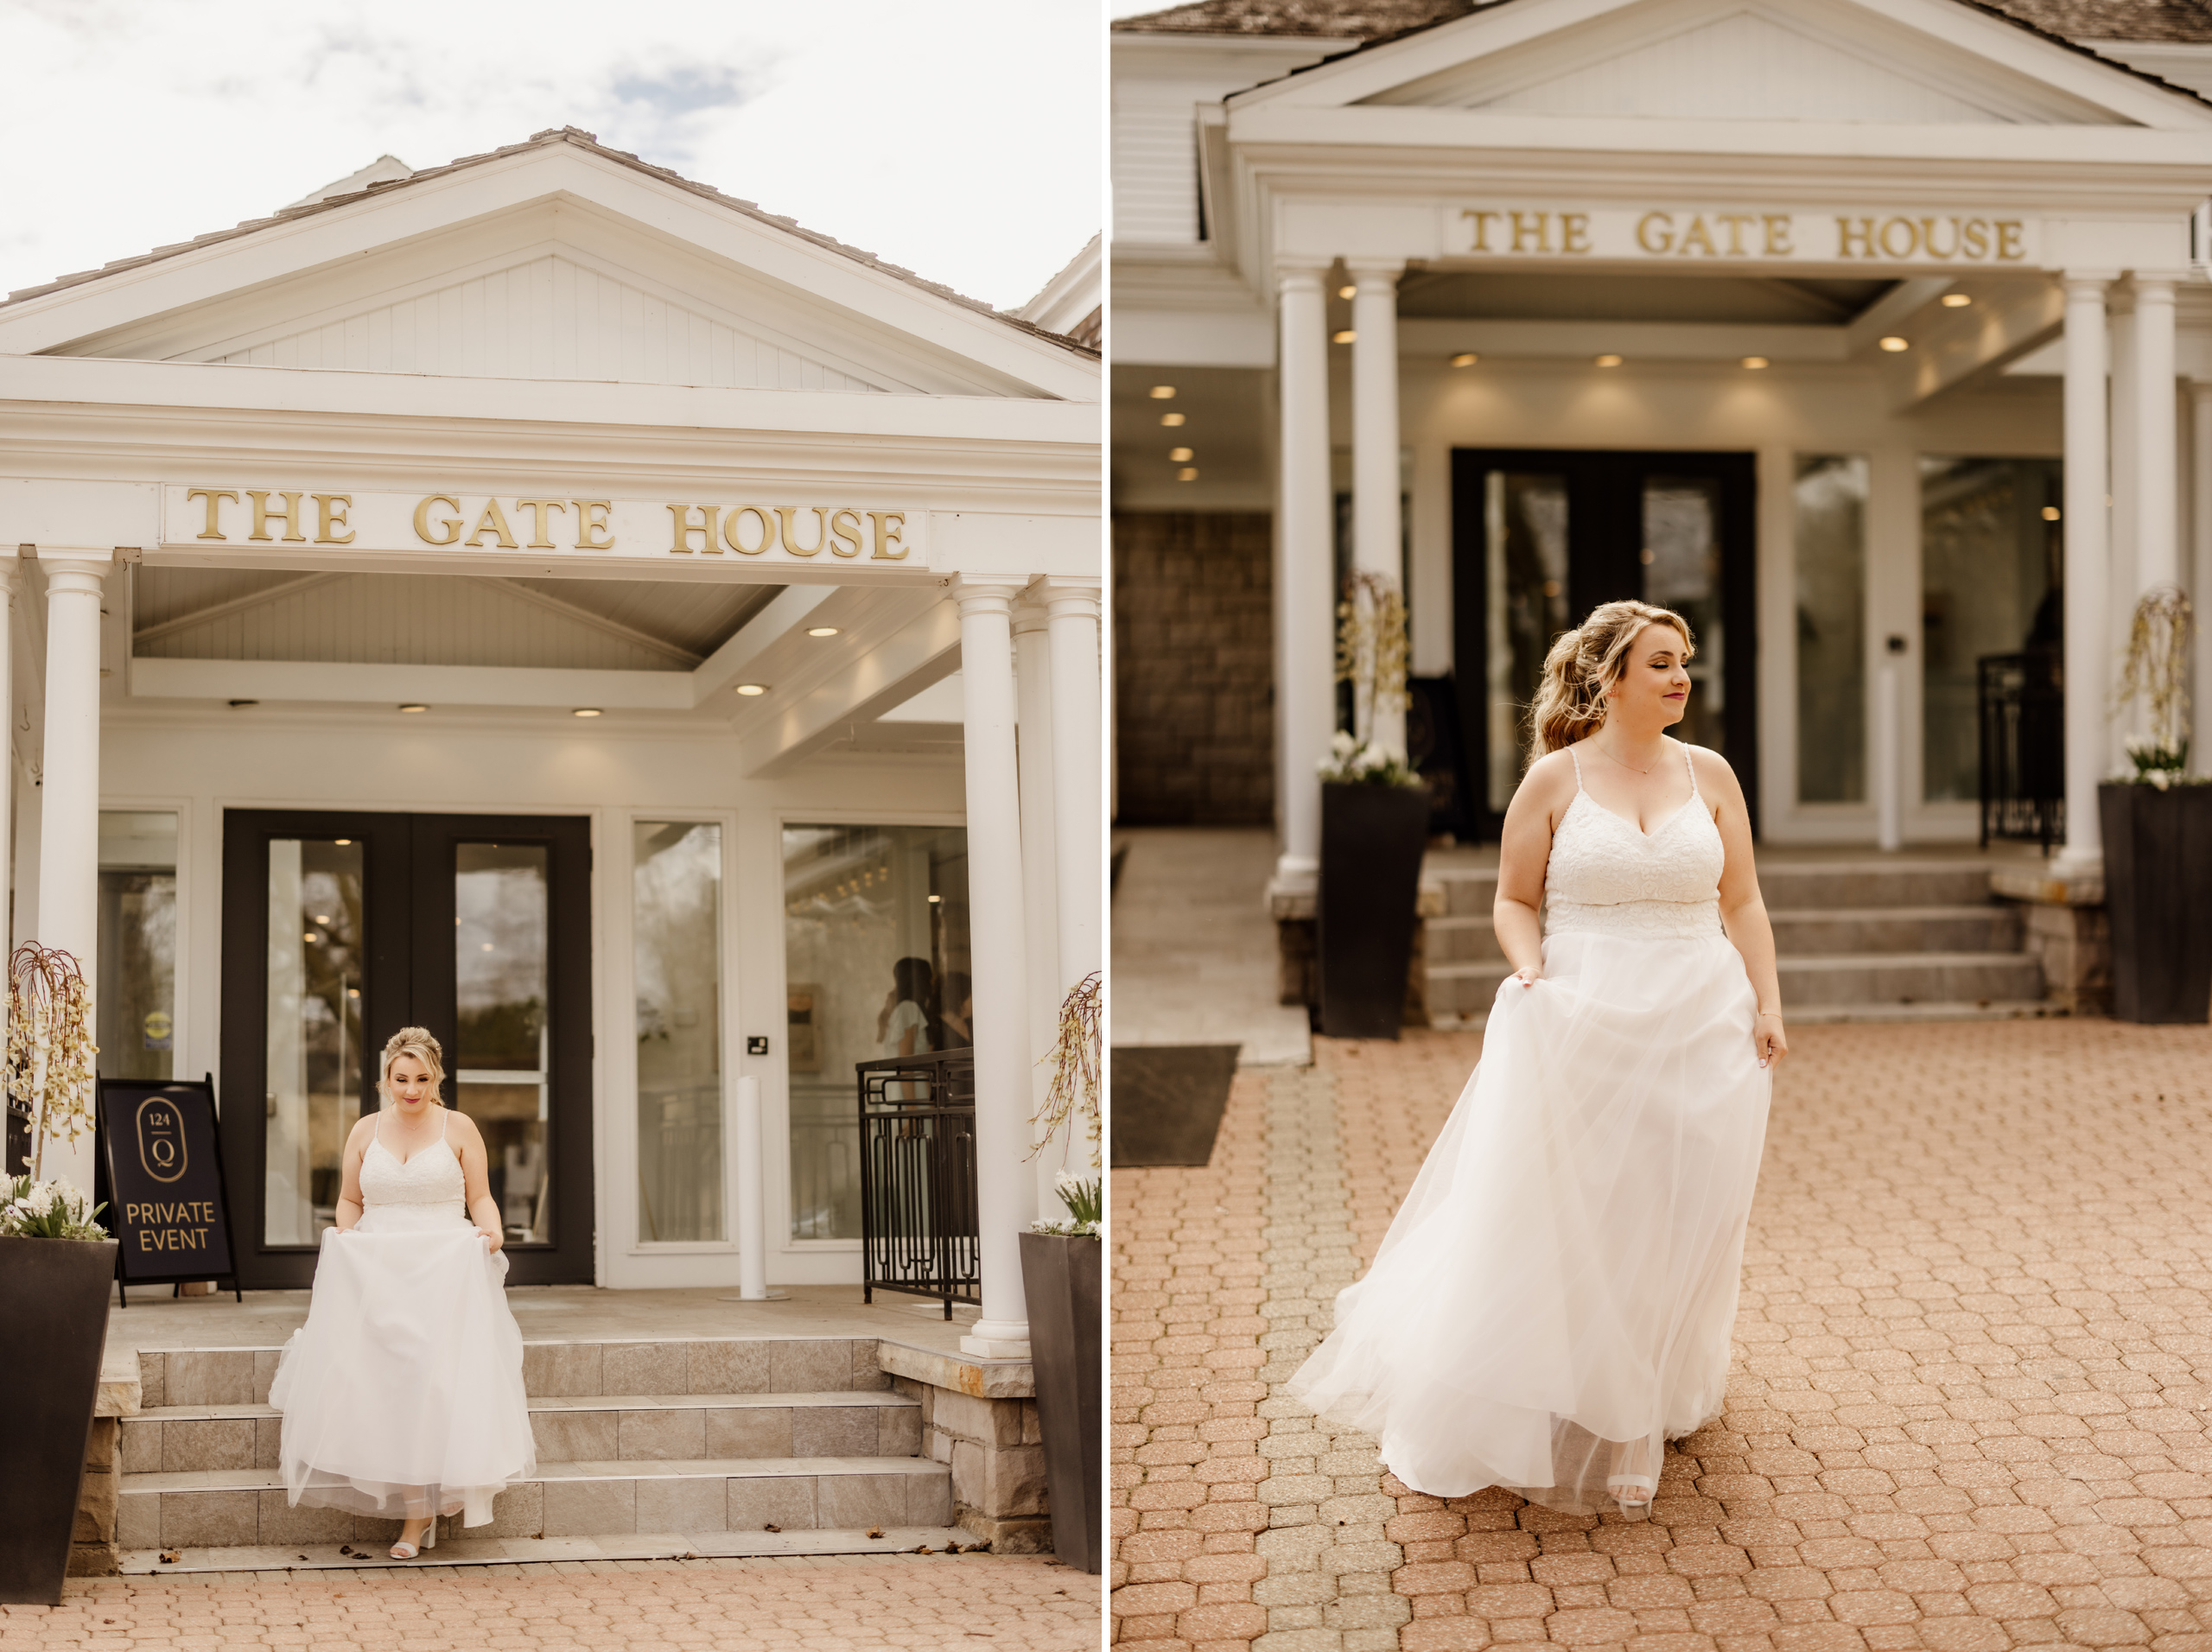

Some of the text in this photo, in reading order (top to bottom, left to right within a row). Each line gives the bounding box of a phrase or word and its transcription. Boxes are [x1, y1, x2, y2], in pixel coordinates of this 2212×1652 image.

[1461, 210, 2025, 260] THE GATE HOUSE
[187, 488, 910, 560] THE GATE HOUSE
[149, 1113, 170, 1126] 124
[152, 1139, 175, 1167] Q
[126, 1202, 215, 1224] PRIVATE
[139, 1228, 208, 1251] EVENT
